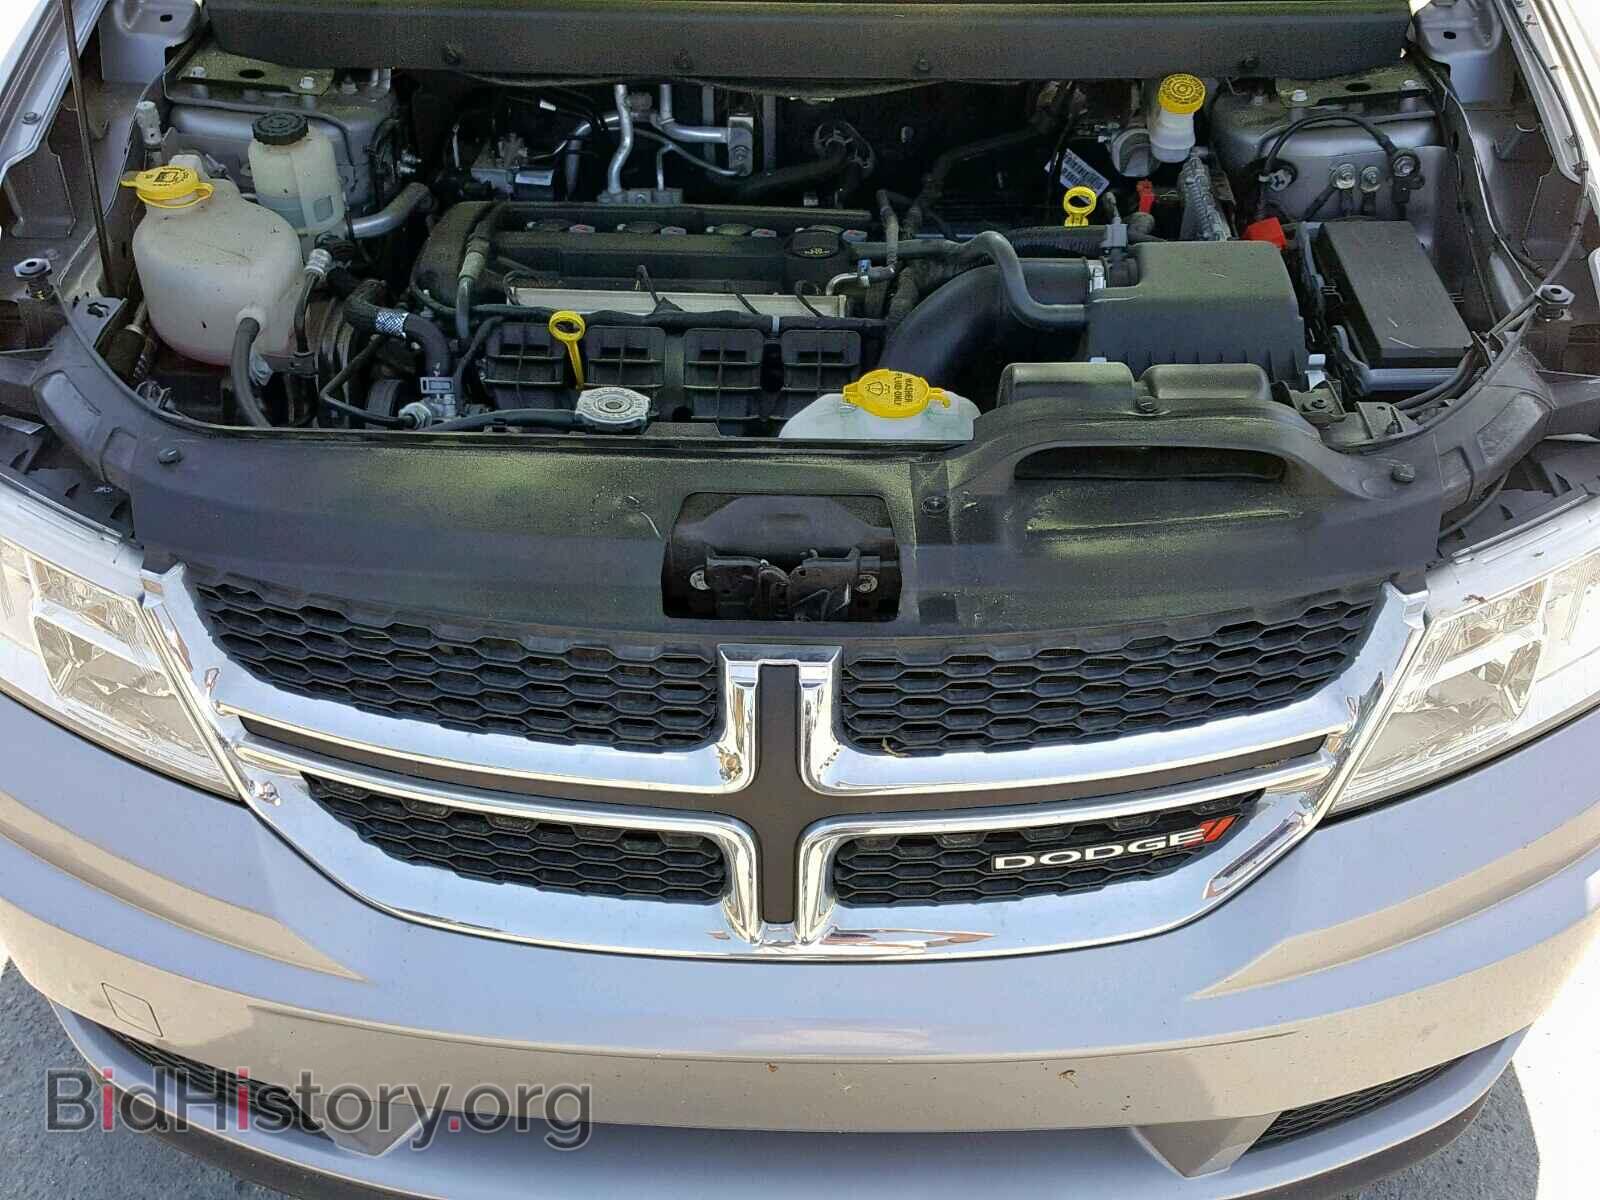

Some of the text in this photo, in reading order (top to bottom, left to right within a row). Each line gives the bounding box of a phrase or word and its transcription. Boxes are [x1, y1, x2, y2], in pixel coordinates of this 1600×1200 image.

[893, 373, 903, 406] FLUID ONLY
[903, 377, 914, 403] WASHER
[995, 828, 1205, 870] DODGE
